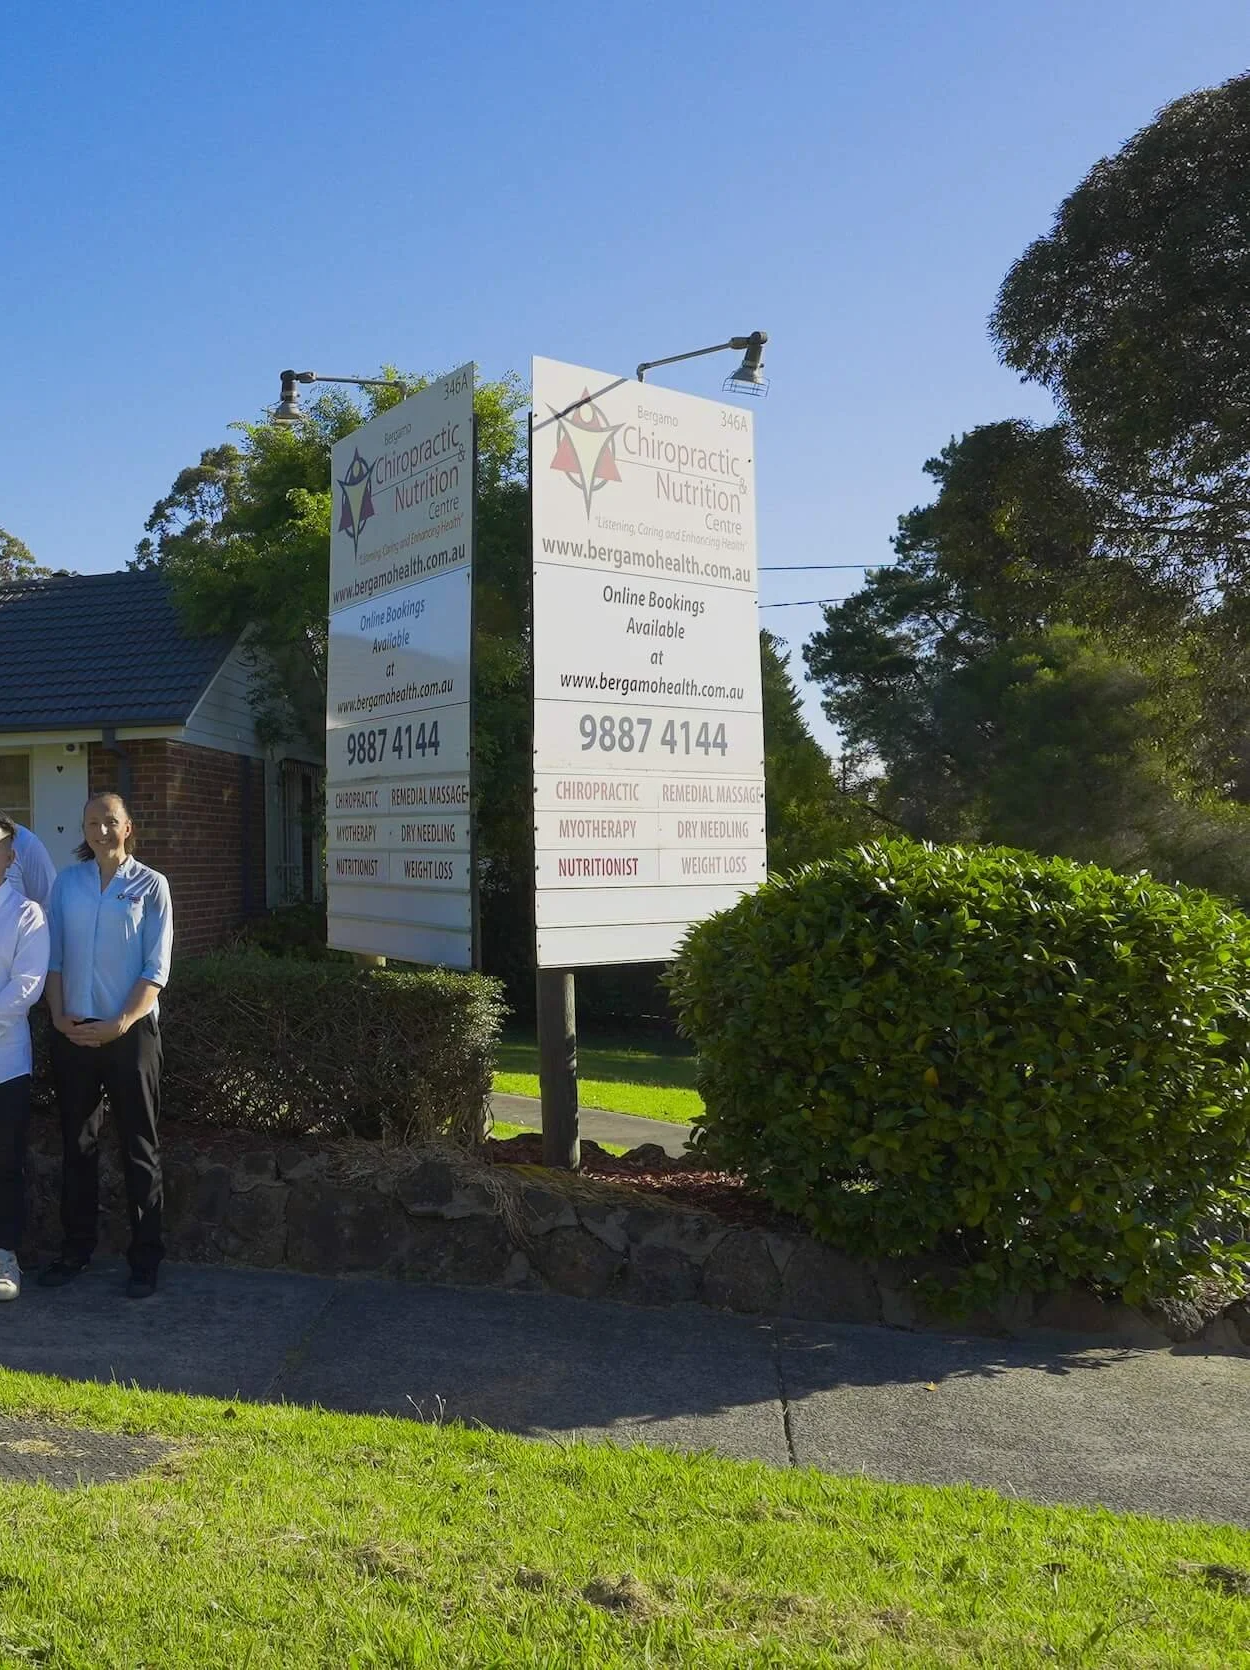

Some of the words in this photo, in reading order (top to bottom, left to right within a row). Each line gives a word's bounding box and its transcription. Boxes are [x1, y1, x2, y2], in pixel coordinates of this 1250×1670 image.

[443, 372, 468, 400] 346A
[637, 405, 679, 427] Bergamo
[720, 410, 749, 433] 346A
[376, 421, 460, 485] Chiropractic
[458, 443, 466, 462] &
[623, 425, 741, 478] Chiropractic
[738, 477, 748, 495] &
[395, 465, 459, 512] Nutrition
[656, 471, 741, 514] Nutrition
[429, 497, 459, 520] Centre
[705, 513, 742, 536] Centre
[637, 522, 664, 541] Caring
[665, 529, 680, 542] and
[681, 530, 721, 551] Enhancing
[542, 537, 750, 583] www.bergamohealth.com.au
[333, 543, 465, 604] www.bergamohealth.com.au
[603, 585, 646, 607] Online
[648, 590, 705, 617] Bookings
[360, 611, 385, 631] Online
[386, 599, 425, 623] Bookings
[626, 616, 685, 640] Available
[373, 627, 410, 654] Available
[386, 661, 395, 677] at
[650, 650, 664, 666] at
[337, 679, 454, 714] www.bergamohealth.com.au
[560, 672, 744, 700] www.bergamohealth.com.au
[347, 728, 388, 766] 9887
[392, 720, 440, 760] 4144
[579, 713, 653, 753] 9887
[660, 719, 728, 757] 4144
[335, 790, 379, 809] CHIROPRACTIC
[391, 787, 428, 807] REMEDIAL
[429, 785, 467, 805] MASSAGE
[556, 781, 639, 801] CHIROPRACTIC
[662, 784, 714, 803] REMEDIAL
[716, 785, 762, 804] MASSAGE
[336, 826, 377, 843] MYOTHERAPY
[401, 825, 416, 842] DRY
[417, 824, 456, 842] NEEDLING
[559, 819, 638, 839] MYOTHERAPY
[677, 820, 698, 839] DRY
[700, 820, 749, 840] NEEDLING
[336, 859, 379, 876] NUTRITIONIST
[404, 860, 433, 879] WEIGHT
[434, 861, 454, 880] LOSS
[558, 857, 639, 877] NUTRITIONIST
[681, 856, 722, 875] WEIGHT
[724, 856, 747, 874] LOSS
